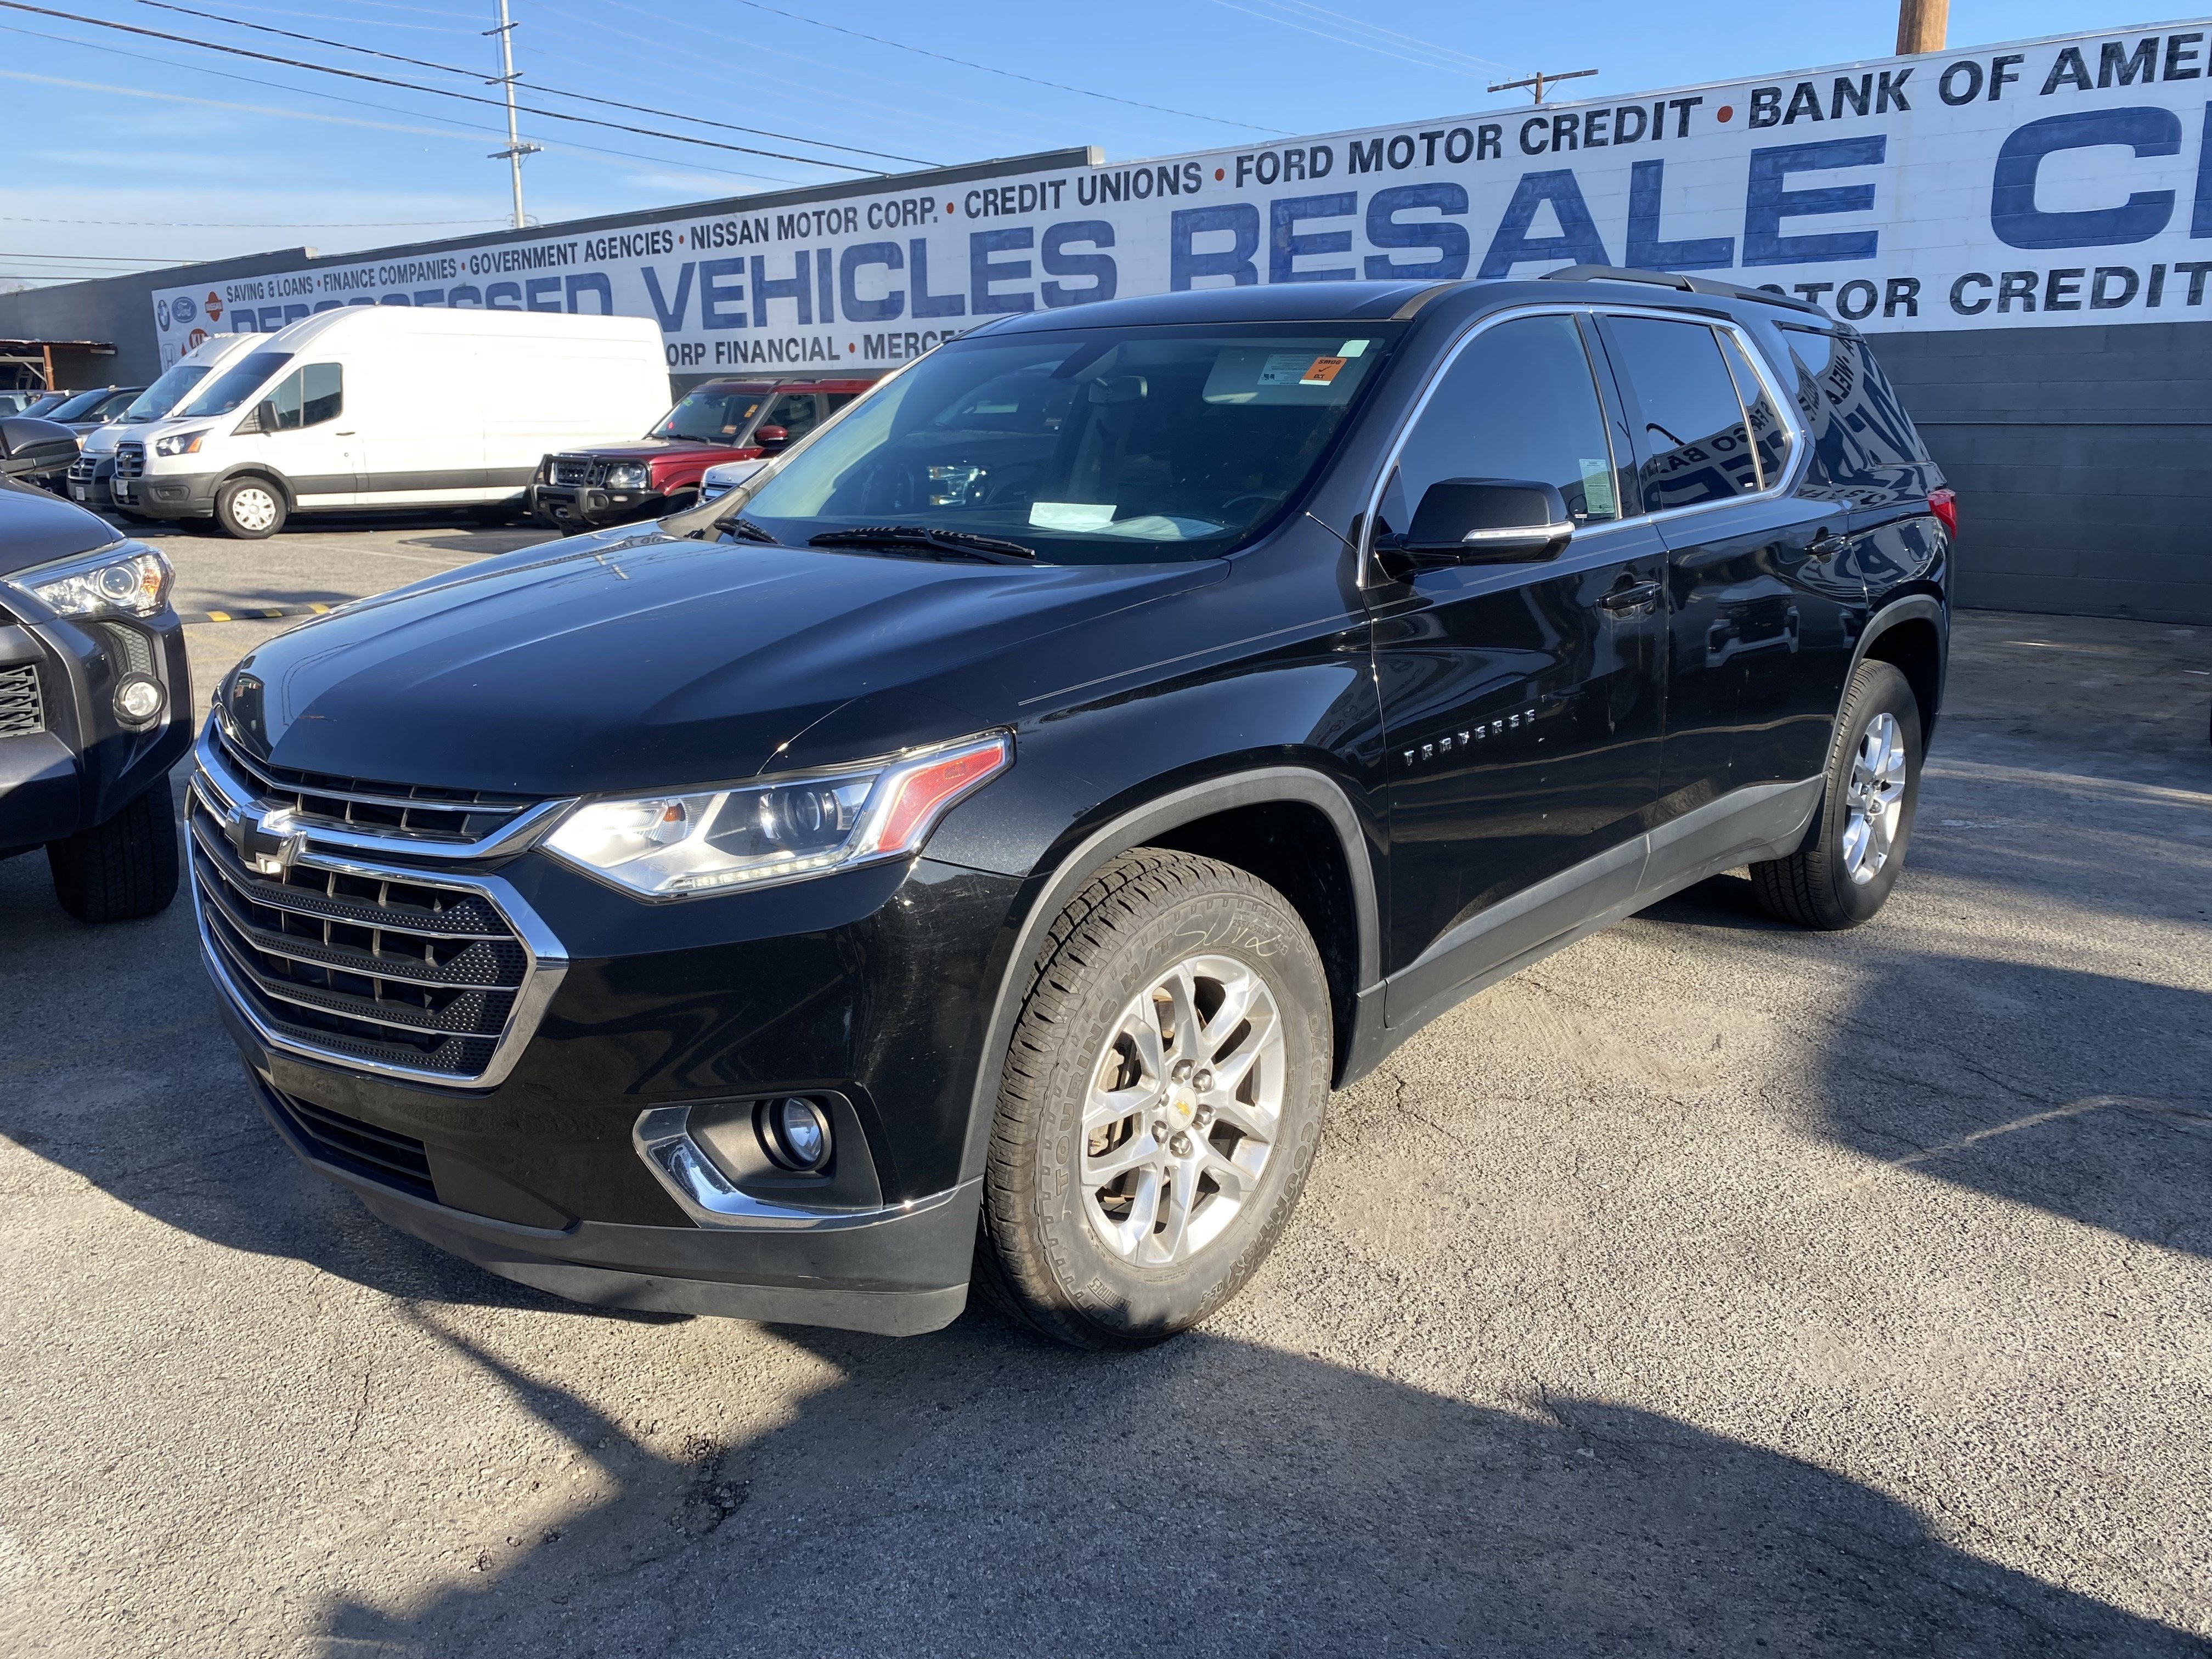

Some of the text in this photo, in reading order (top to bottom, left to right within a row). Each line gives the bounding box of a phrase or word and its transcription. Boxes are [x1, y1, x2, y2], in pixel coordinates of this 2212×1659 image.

[227, 32, 2212, 302] SAVING & LOANS FINANCE COMPANIES GOVERNMENT AGENCIES NISSAN MOTOR CORP. CREDIT UNIONS FORD MOTOR CREDIT BANK OF AME
[641, 220, 1118, 332] VEHICLES
[1170, 134, 1887, 292] RESALE
[1991, 100, 2212, 250] C
[715, 336, 840, 365] FINANCIAL
[1950, 261, 2212, 315] CREDIT
[1403, 709, 1536, 766] TRAVERSE
[1055, 999, 1118, 1196] TOURING
[1120, 933, 1173, 992] H/T
[1307, 1010, 1323, 1109] BACK
[1228, 1121, 1314, 1285] COUNTRY
